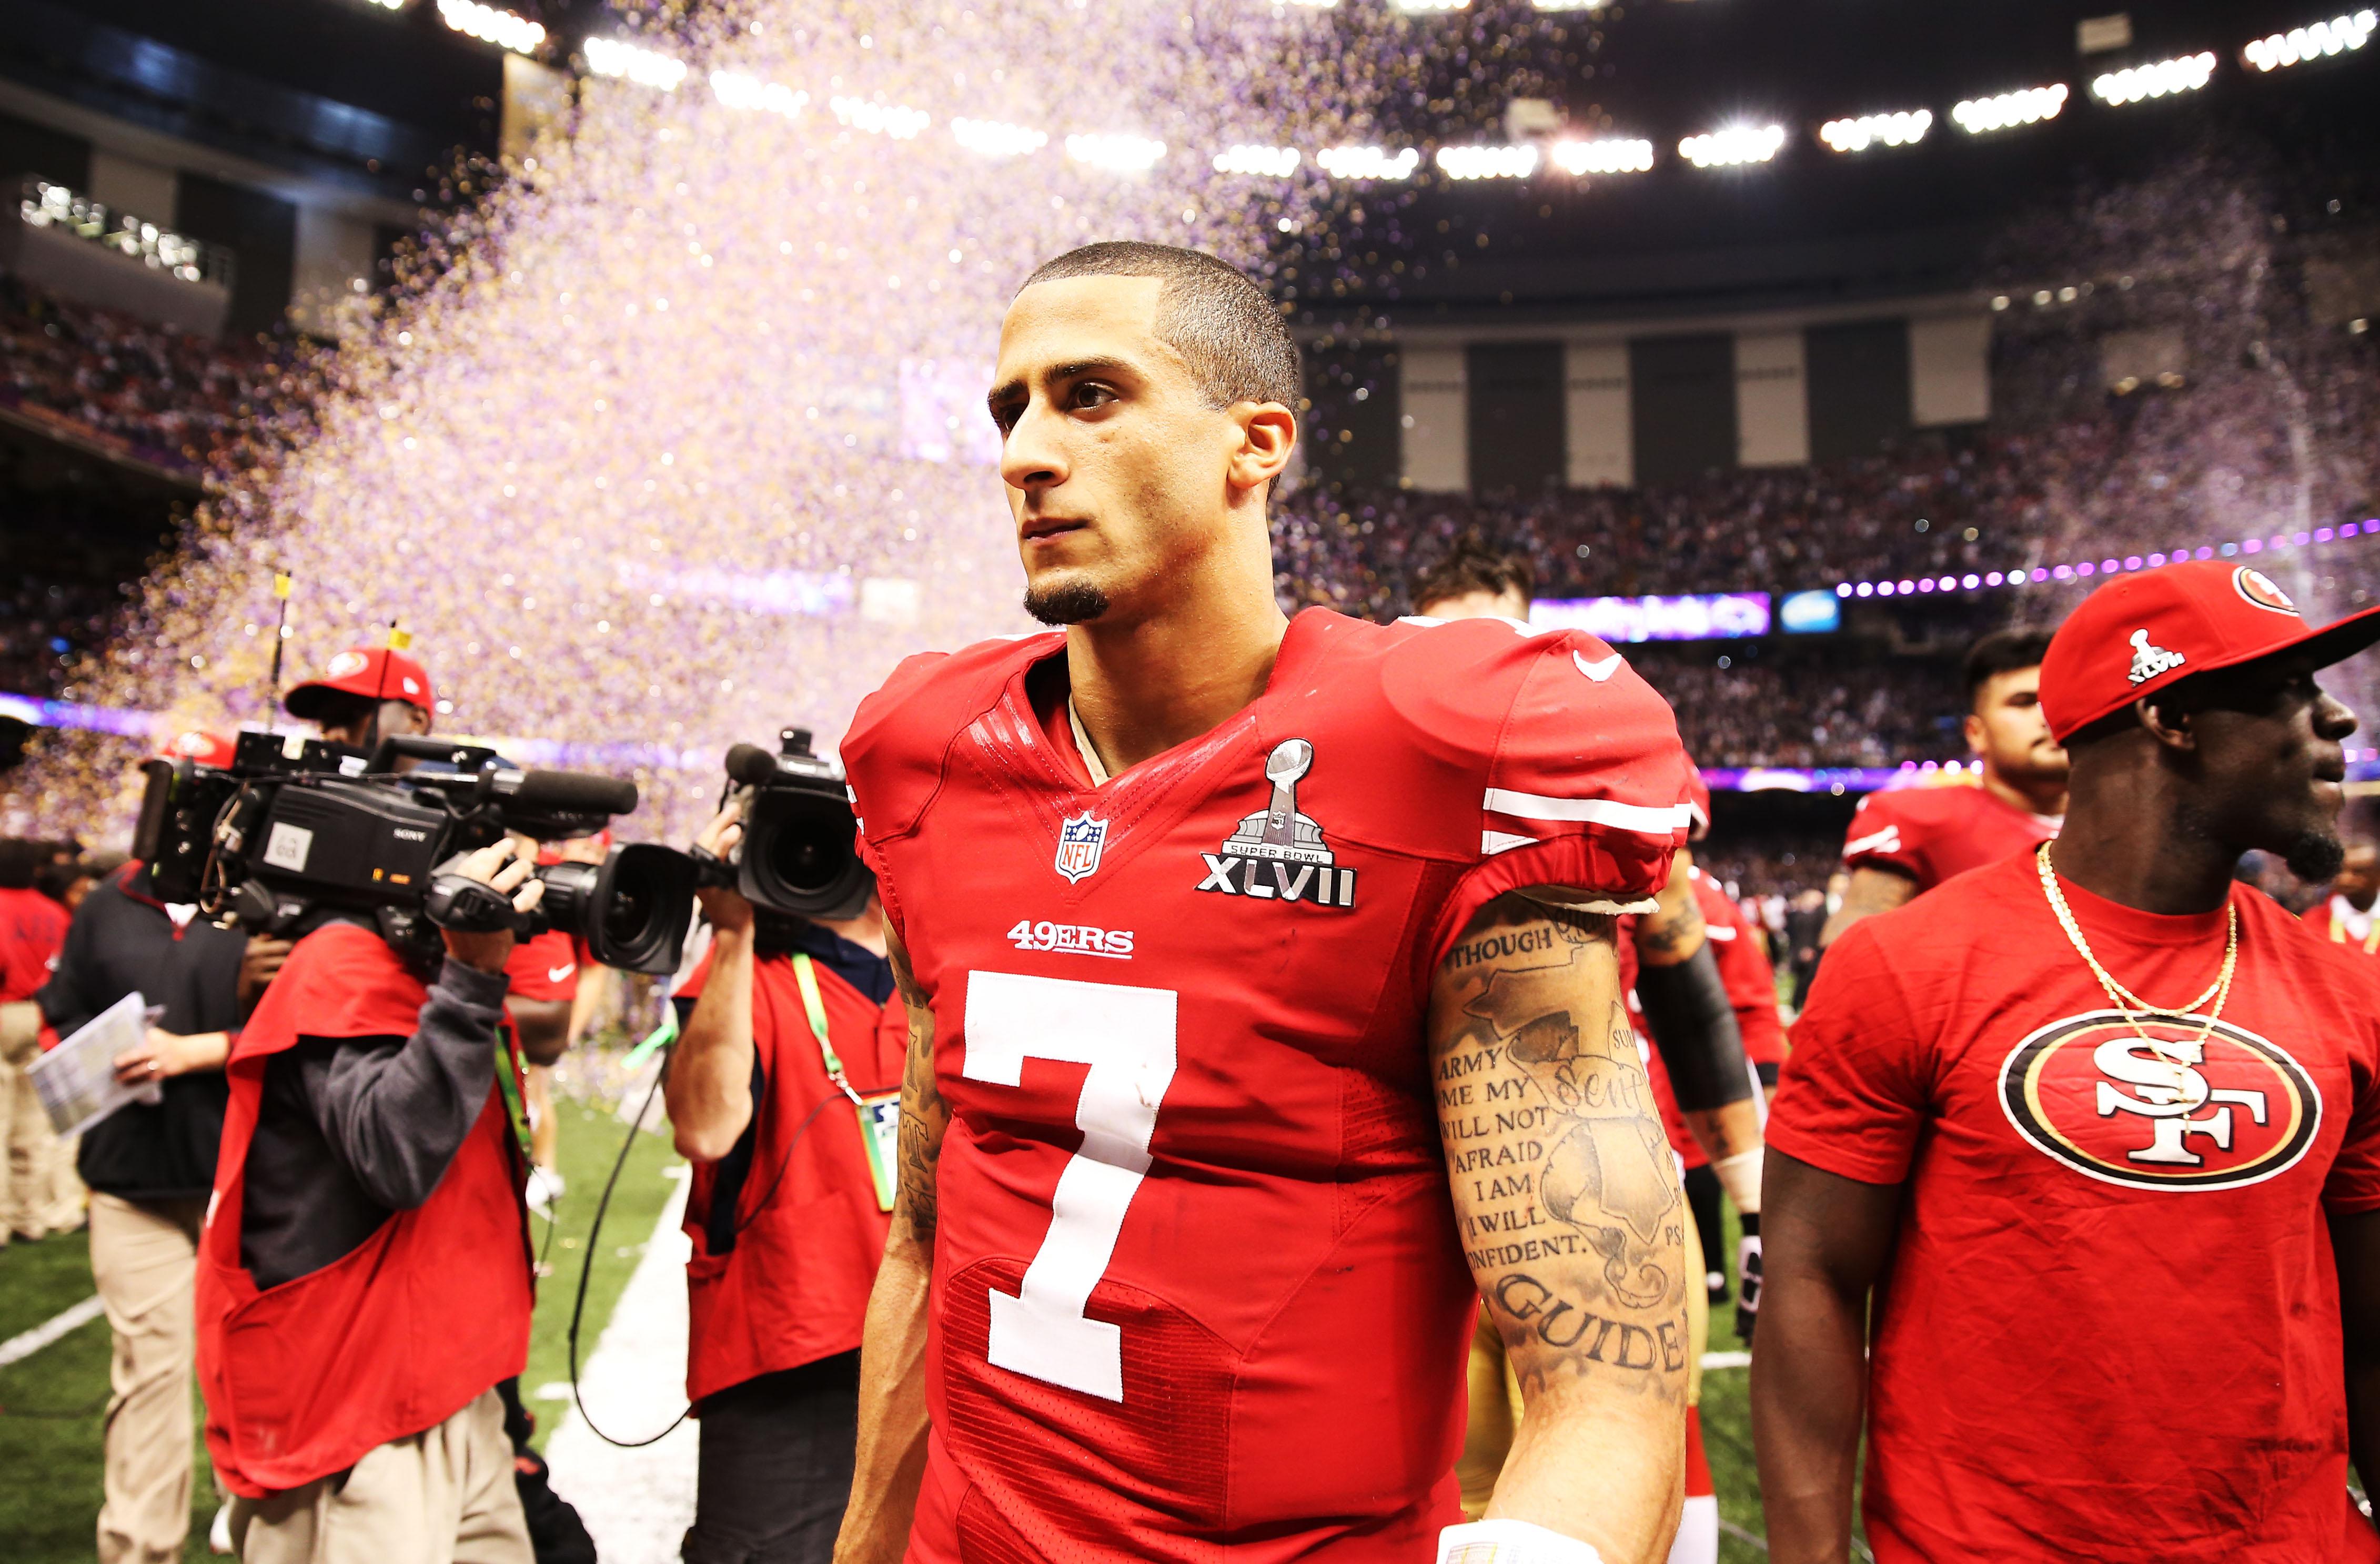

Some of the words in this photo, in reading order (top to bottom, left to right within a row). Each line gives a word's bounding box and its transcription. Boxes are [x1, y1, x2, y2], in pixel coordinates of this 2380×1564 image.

[1062, 844, 1092, 870] NFL
[1231, 845, 1277, 860] SUPER
[1284, 851, 1323, 864] BOWL
[1195, 852, 1354, 906] XLVII
[1007, 920, 1134, 956] 49ERS
[1451, 927, 1552, 968] THOUGH
[1440, 1047, 1503, 1080] ARMY
[1440, 1084, 1474, 1108] ME
[1486, 1076, 1529, 1102] MY
[2093, 1037, 2268, 1167] SF
[1496, 1105, 1550, 1134] NOT
[1455, 1141, 1543, 1173] AFRAID
[963, 970, 1178, 1403] 7
[1474, 1180, 1484, 1202] I
[1490, 1173, 1532, 1199] AM
[1469, 1216, 1477, 1237] I
[1477, 1207, 1546, 1233] WILL
[1496, 1273, 1684, 1372] GUIDE
